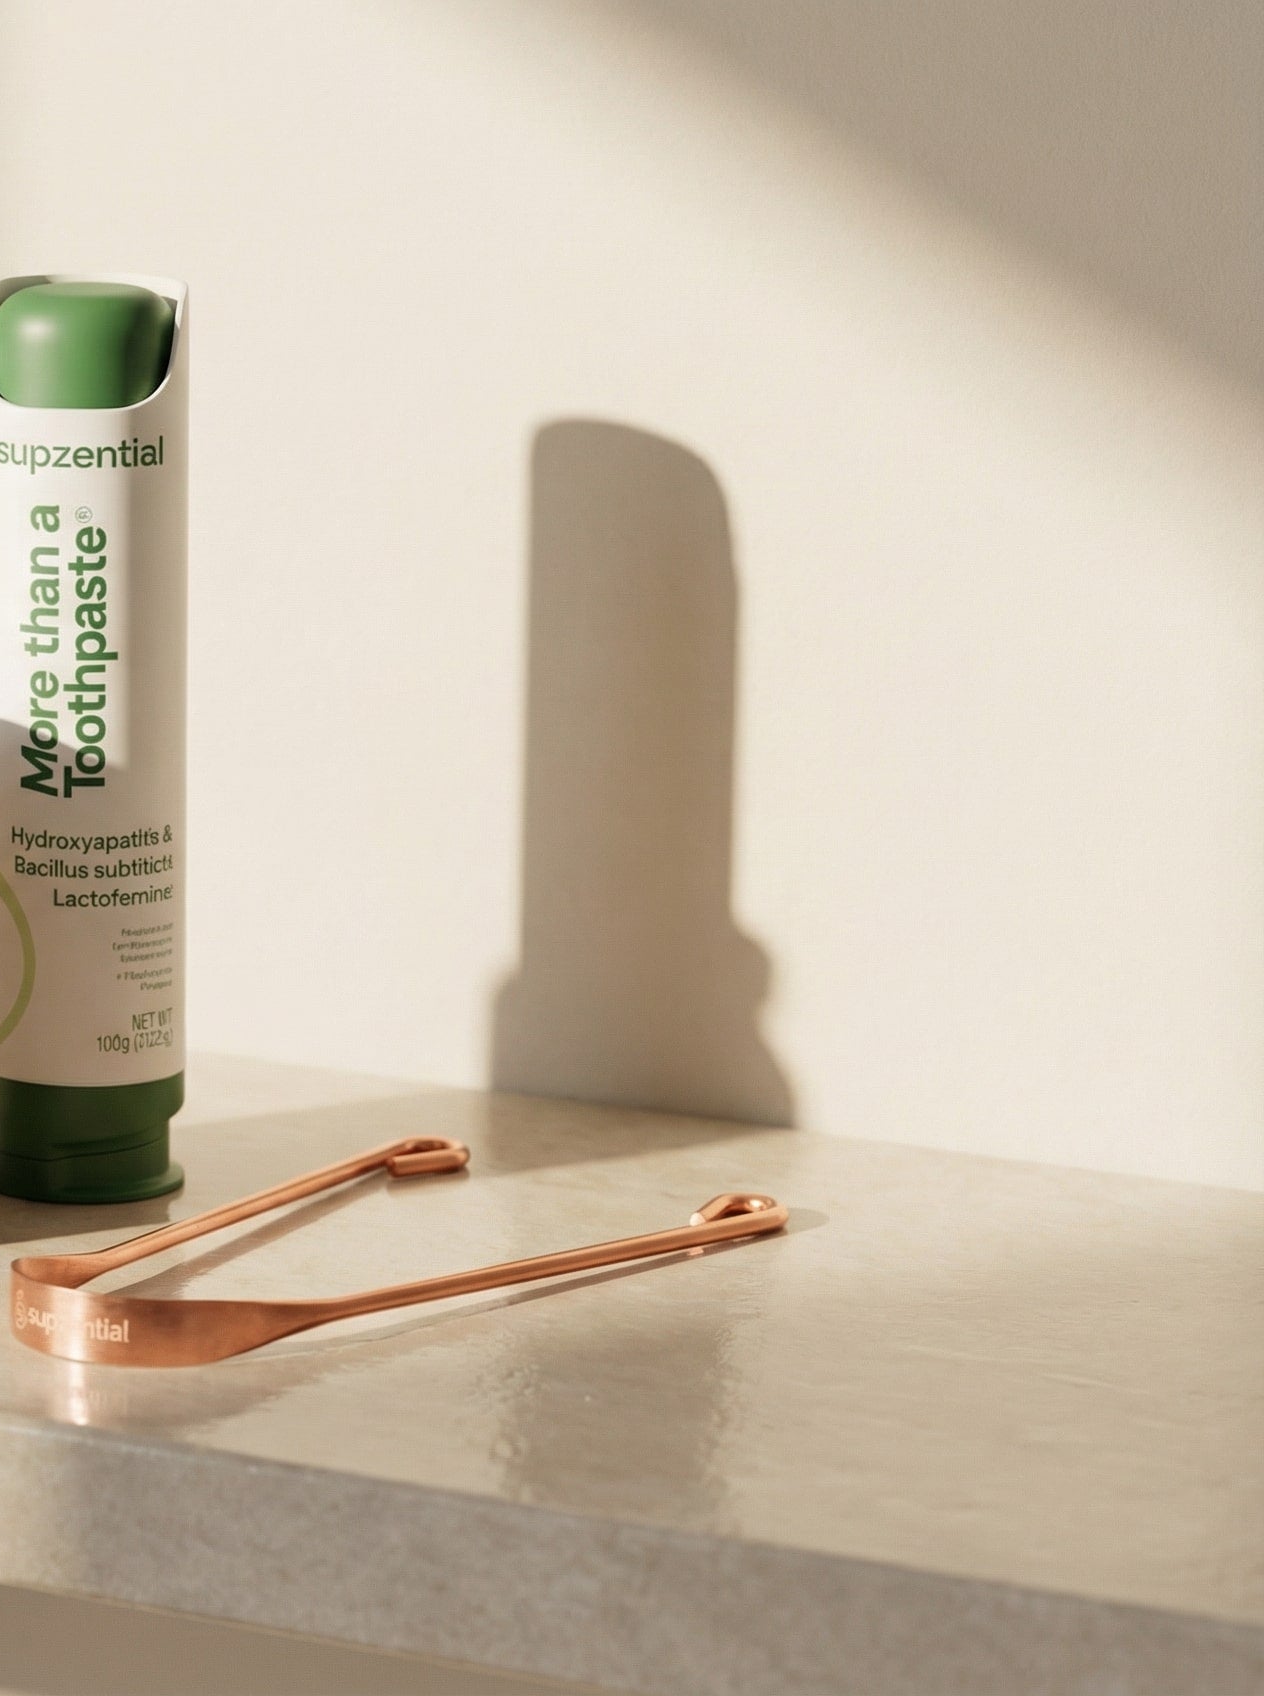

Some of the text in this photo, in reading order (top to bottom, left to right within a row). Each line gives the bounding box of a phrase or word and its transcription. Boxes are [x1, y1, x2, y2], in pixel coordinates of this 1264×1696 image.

[19, 504, 60, 798] More than a
[162, 824, 173, 843] &
[14, 855, 89, 879] Bacillus
[132, 1011, 156, 1031] NET
[97, 1033, 130, 1054] 100g
[27, 1306, 130, 1343] supntial
